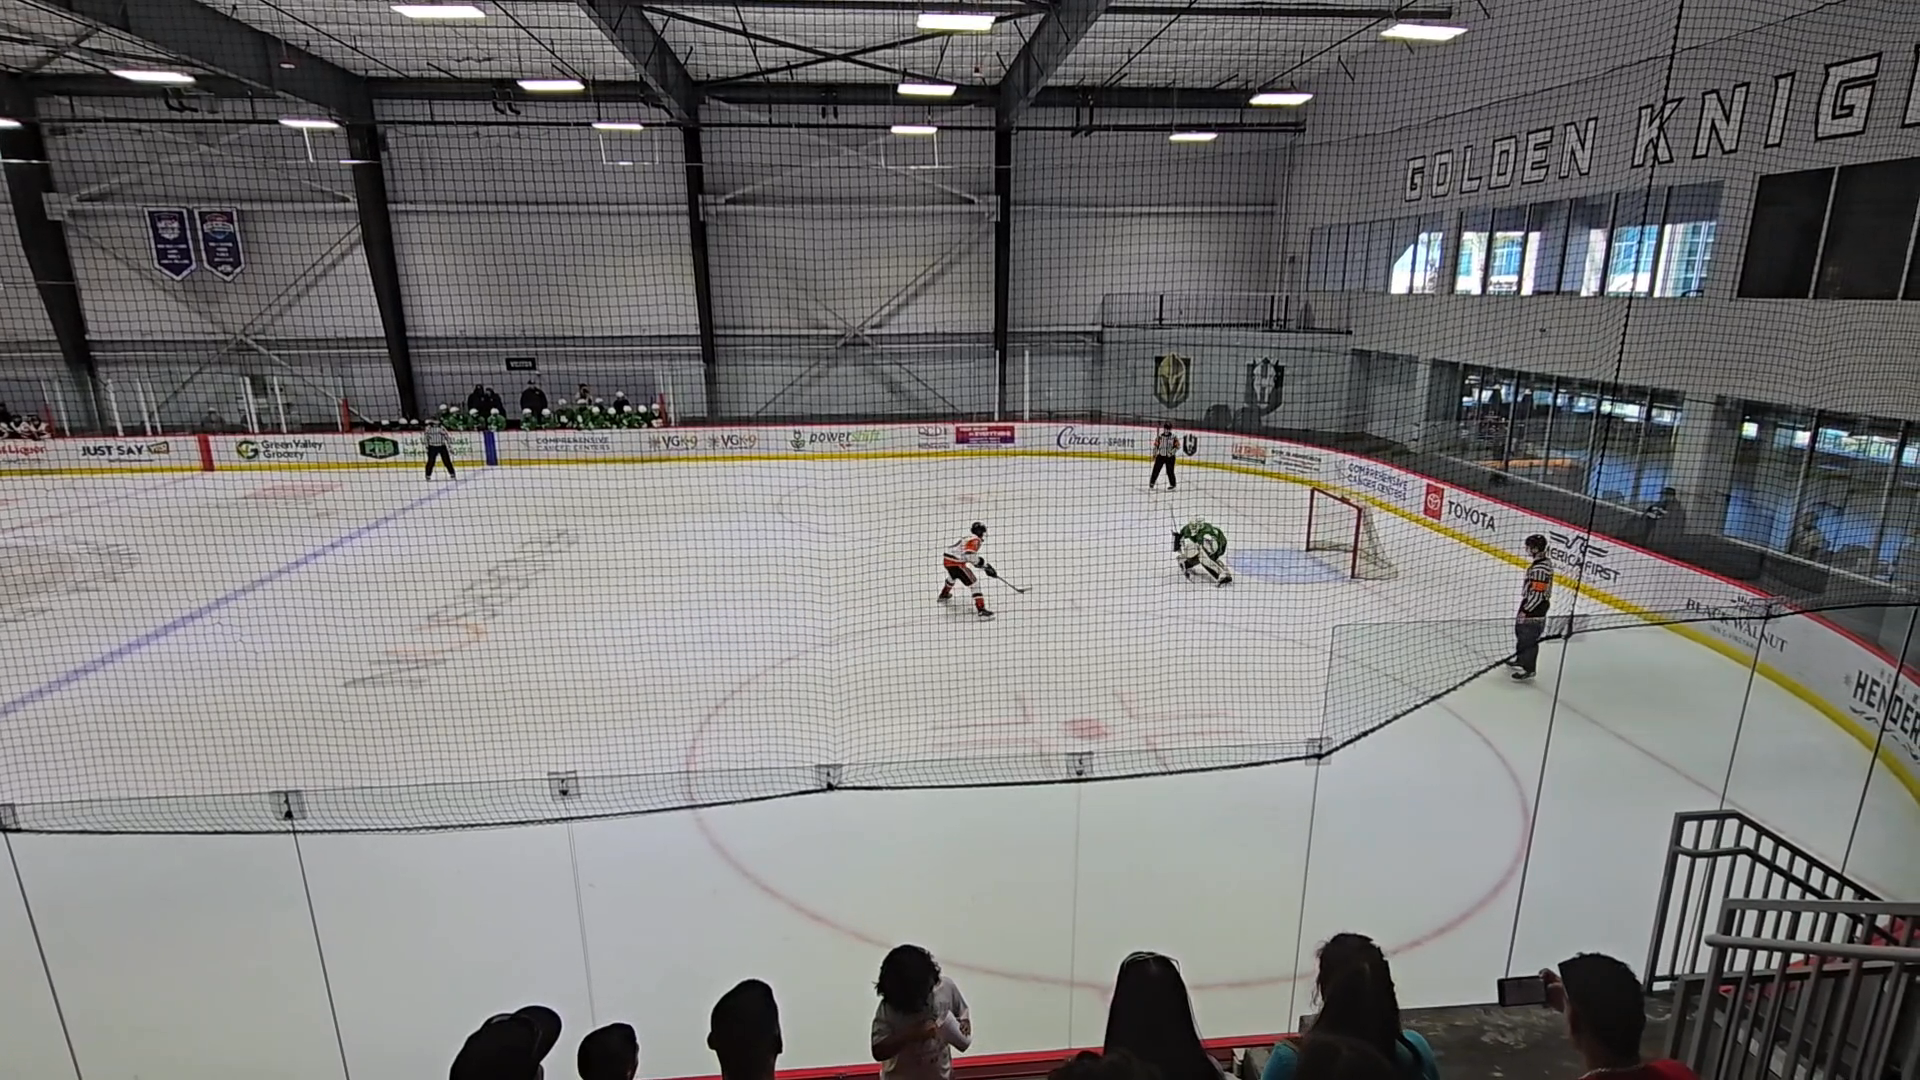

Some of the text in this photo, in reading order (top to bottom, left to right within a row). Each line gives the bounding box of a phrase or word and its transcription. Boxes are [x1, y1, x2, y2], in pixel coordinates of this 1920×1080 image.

[1404, 115, 1599, 202] GOLDEN
[261, 439, 323, 451] Green Valley
[1056, 425, 1102, 449] Circa
[8, 444, 46, 456] Liquor
[81, 445, 114, 457] JUST
[116, 444, 144, 456] SAY
[262, 449, 305, 461] Grocery
[1447, 499, 1496, 532] TOYOTA
[1546, 545, 1584, 568] ERICA
[1584, 560, 1621, 584] FIRST
[1733, 619, 1788, 653] WALNUT
